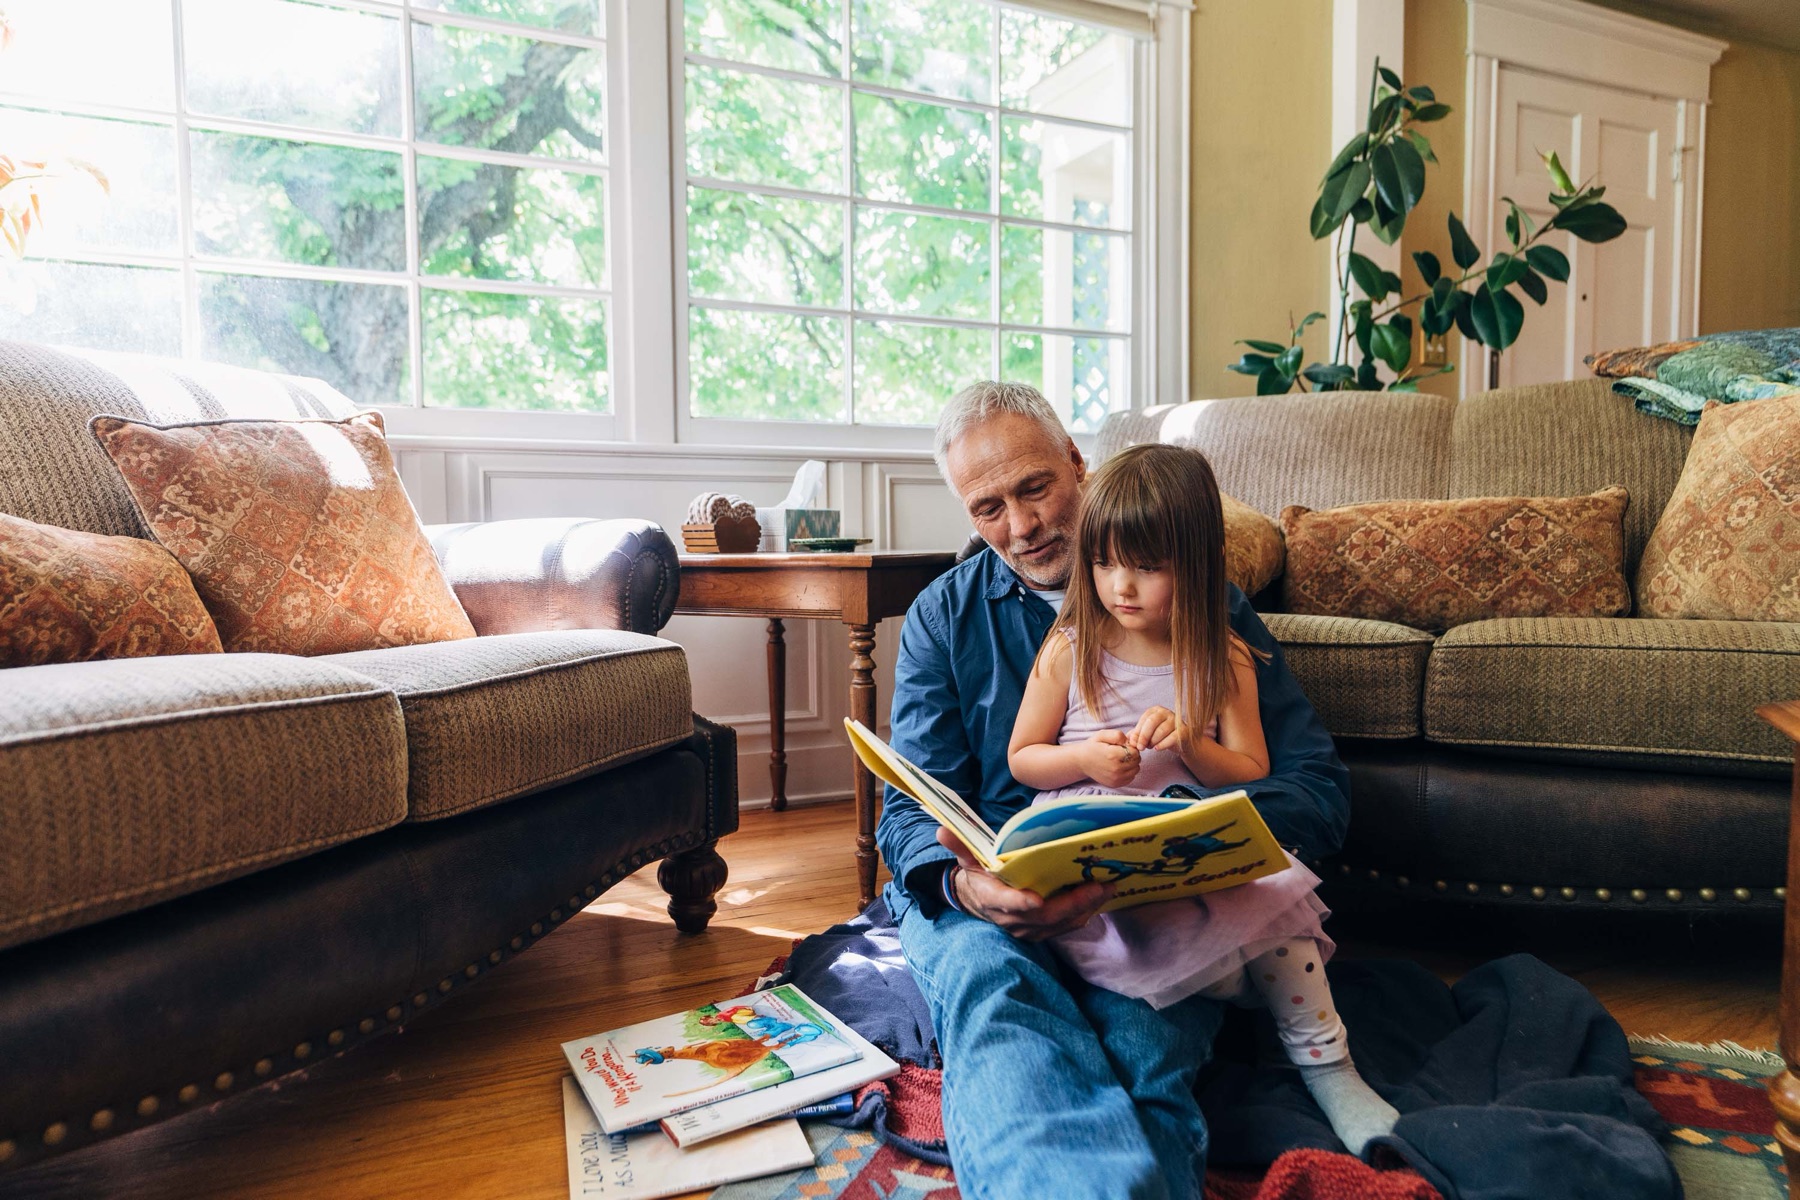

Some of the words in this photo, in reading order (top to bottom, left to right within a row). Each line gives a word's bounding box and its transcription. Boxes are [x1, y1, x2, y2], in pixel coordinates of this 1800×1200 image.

[1182, 859, 1267, 886] George
[581, 1047, 596, 1059] Do
[584, 1058, 601, 1072] You
[795, 1105, 817, 1114] FAMILY
[818, 1103, 837, 1111] PRESS
